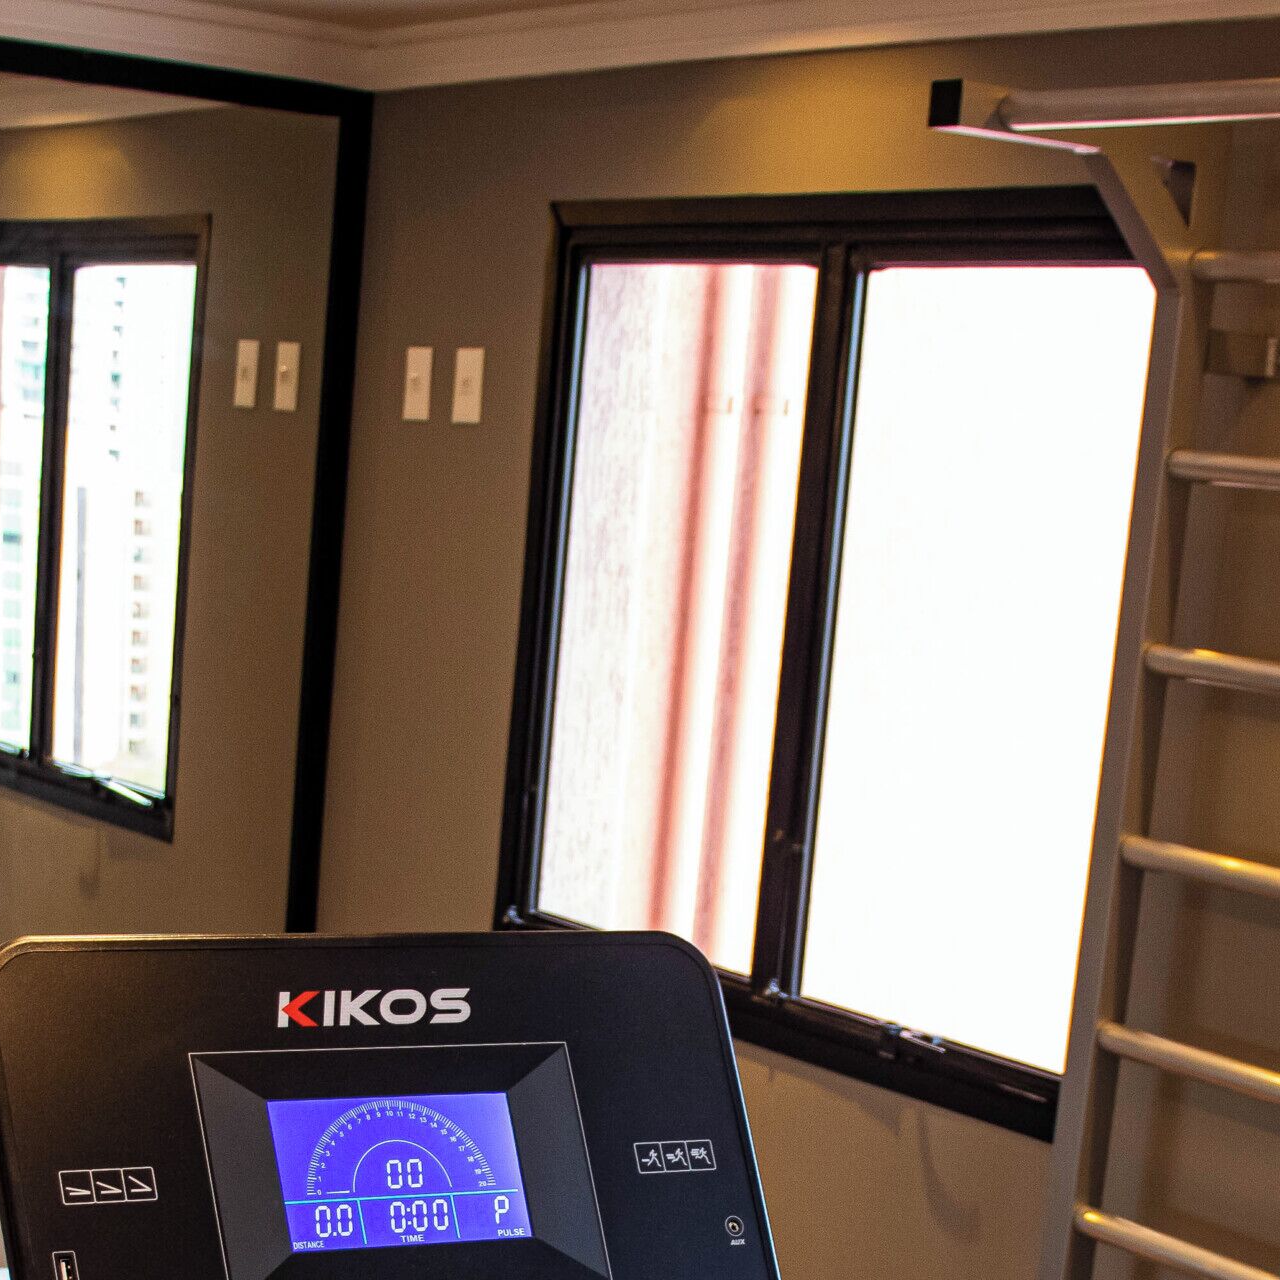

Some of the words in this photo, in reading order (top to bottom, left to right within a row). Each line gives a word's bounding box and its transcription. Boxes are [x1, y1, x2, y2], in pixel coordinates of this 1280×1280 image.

[277, 988, 471, 1028] KIKOS
[387, 1159, 423, 1189] 00
[315, 1204, 353, 1237] 0.0
[390, 1199, 449, 1233] 0:00
[494, 1195, 509, 1224] P
[400, 1235, 424, 1243] TIME
[497, 1228, 525, 1237] PULSE
[293, 1240, 324, 1250] DISTANCE
